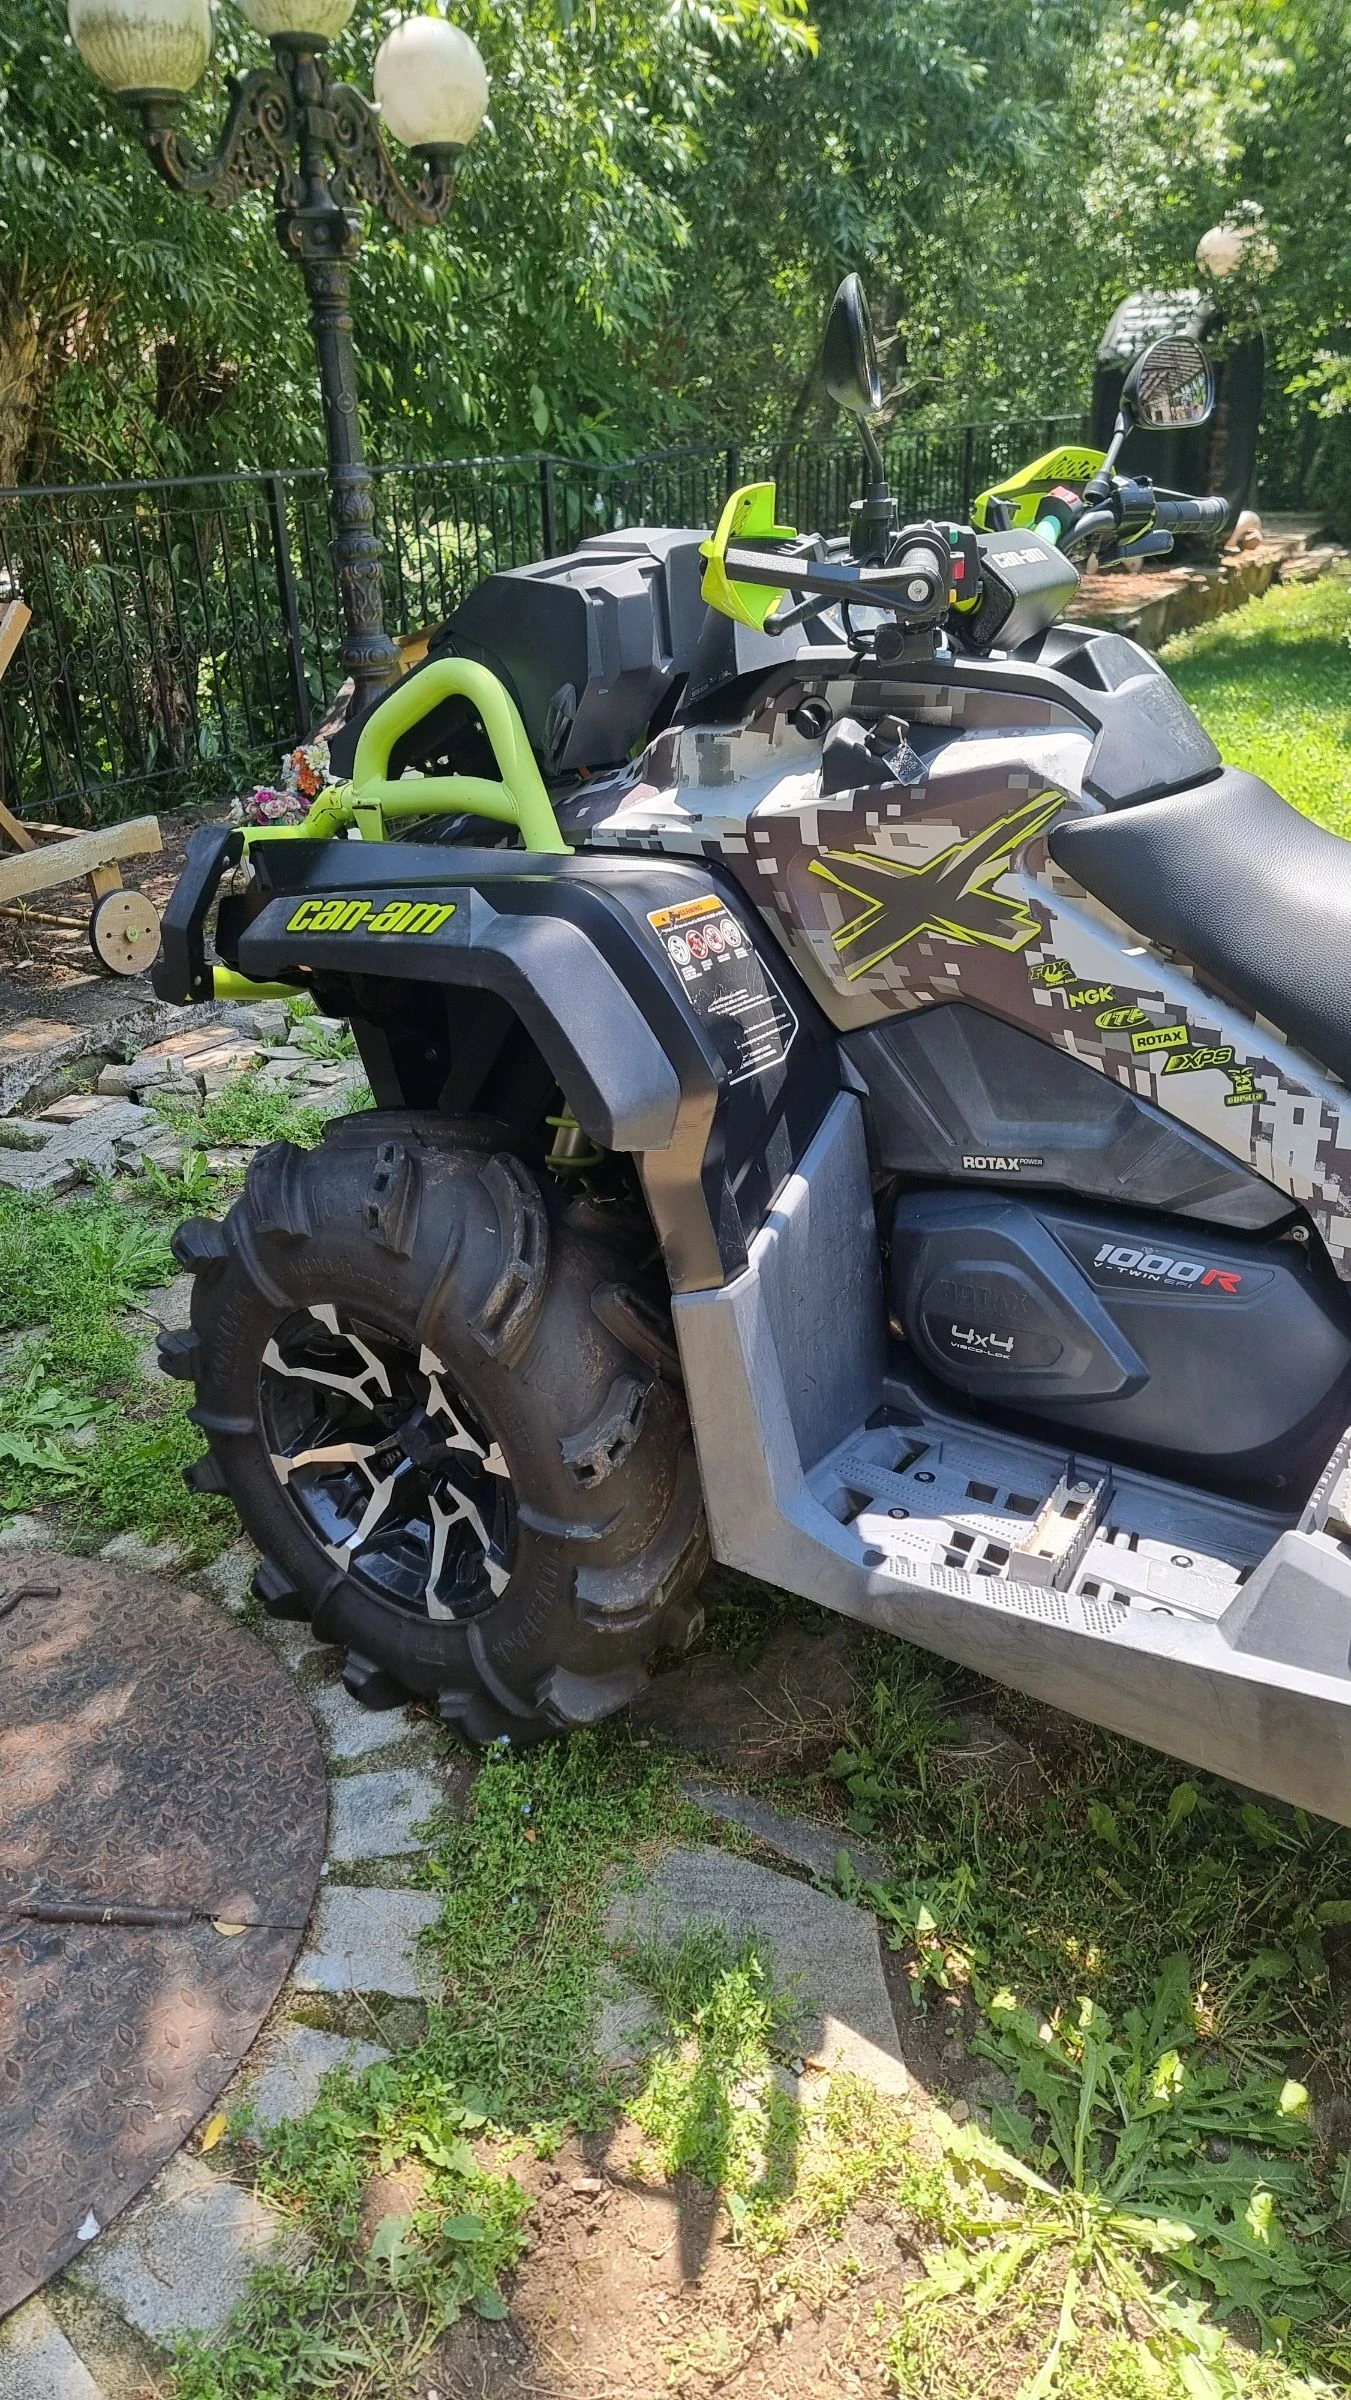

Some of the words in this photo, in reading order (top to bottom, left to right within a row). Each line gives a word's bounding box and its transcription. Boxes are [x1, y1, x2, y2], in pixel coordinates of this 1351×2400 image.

[991, 547, 1049, 569] can-am
[286, 899, 457, 935] can-am
[1029, 960, 1073, 983] FOX
[1069, 985, 1115, 1008] NGK
[1136, 1031, 1183, 1048] ROTAX
[1181, 1047, 1233, 1070] XPS
[962, 1156, 1020, 1170] ROTAX
[1020, 1158, 1043, 1166] POWER
[1094, 1243, 1242, 1293] 1000R
[1163, 1278, 1193, 1289] EFI
[951, 1324, 1014, 1353] 4x4
[950, 1341, 1011, 1360] VISCO-LOK
